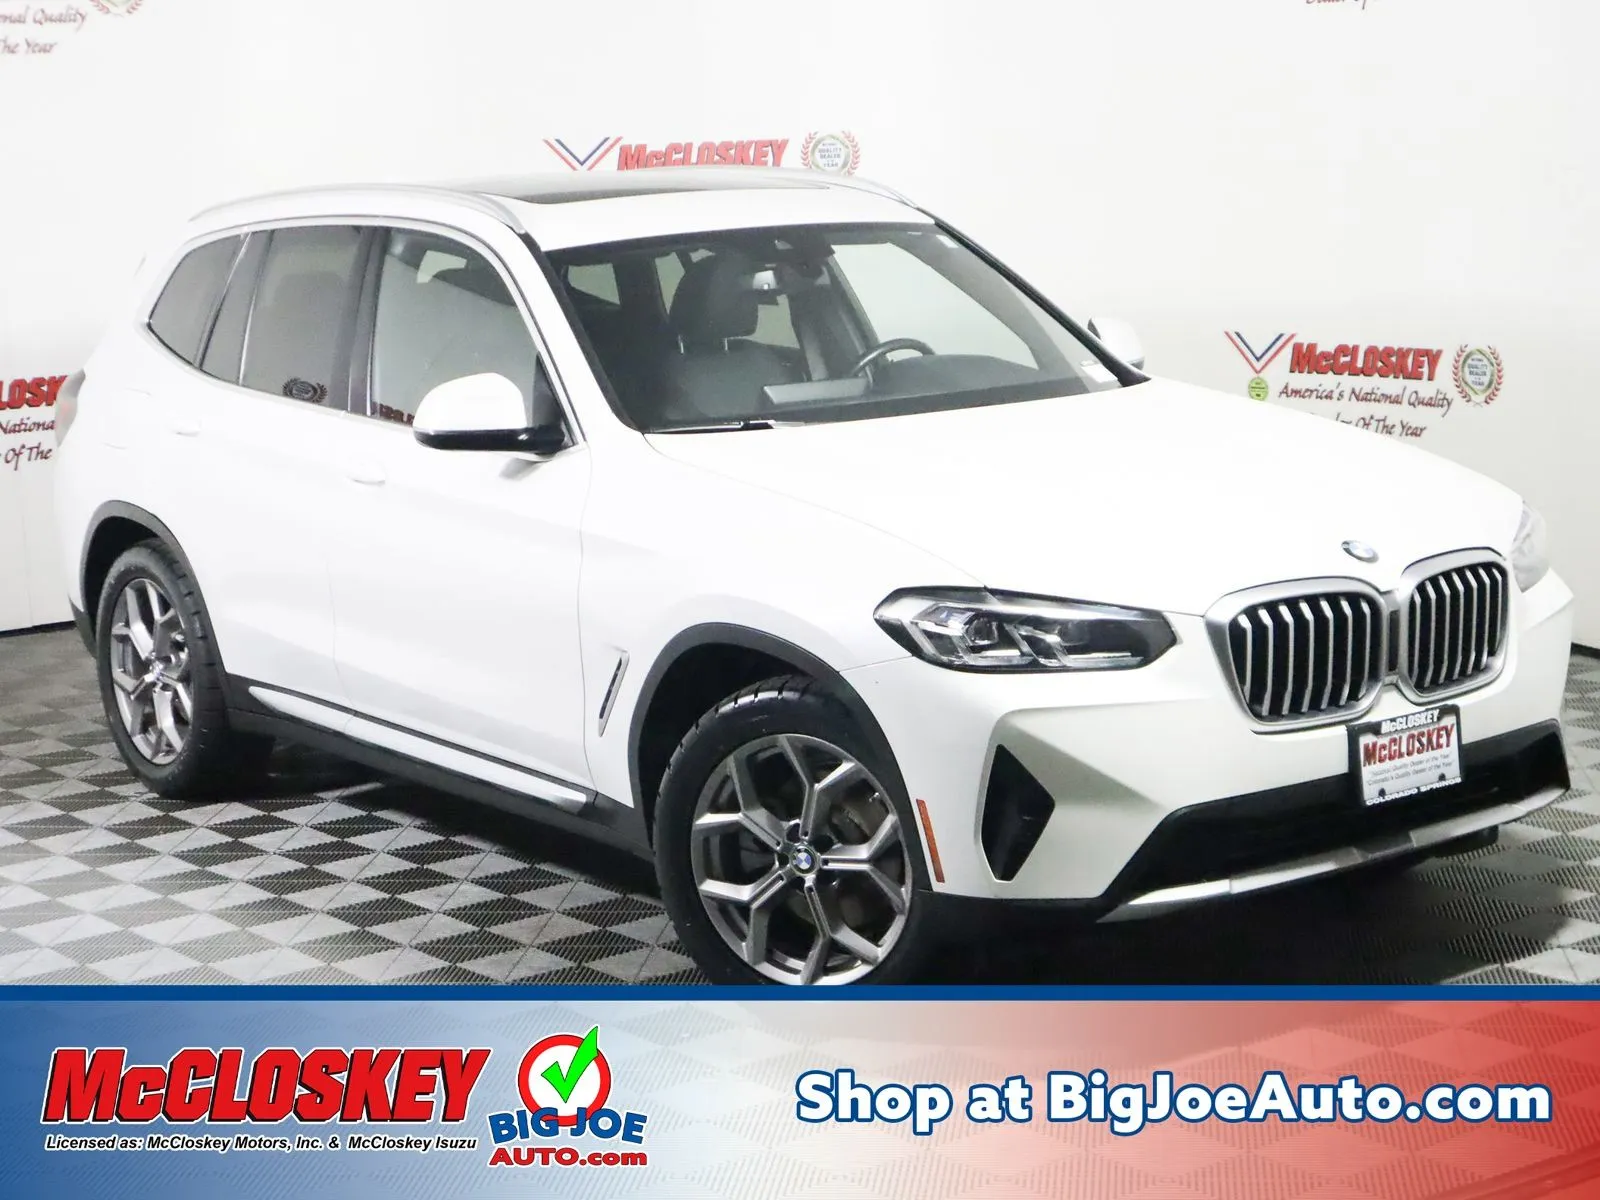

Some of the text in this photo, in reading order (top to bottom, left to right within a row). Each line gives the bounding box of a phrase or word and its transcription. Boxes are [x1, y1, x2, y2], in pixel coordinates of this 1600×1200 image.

[33, 5, 87, 33] Quality
[25, 38, 58, 54] Year
[617, 138, 789, 171] McCLOSKEY
[1289, 342, 1443, 381] McCLOSKEY
[1278, 382, 1345, 401] America's
[1349, 385, 1407, 406] National
[1408, 388, 1454, 418] Quality
[1355, 414, 1375, 430] Of
[1375, 415, 1396, 436] The
[1399, 419, 1428, 438] Year
[4, 442, 52, 471] Of The
[1381, 708, 1440, 734] McCLOSKEY
[1363, 723, 1455, 768] McCLOSKEY
[1366, 777, 1462, 806] COLORADO SPRINGS
